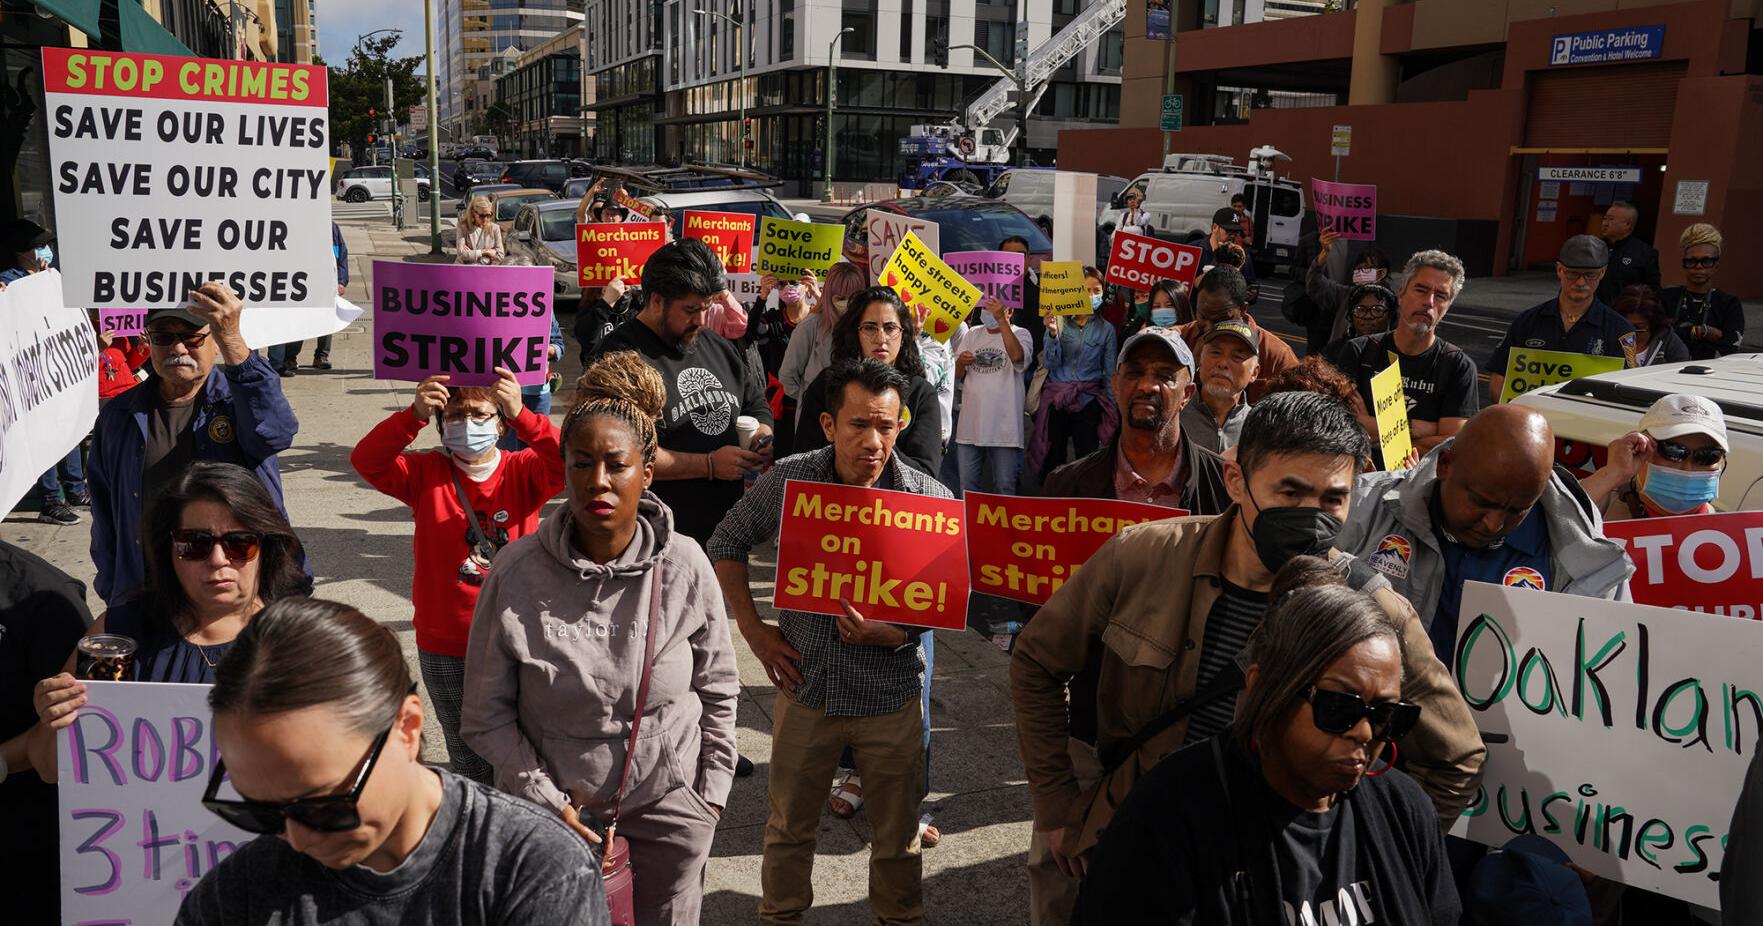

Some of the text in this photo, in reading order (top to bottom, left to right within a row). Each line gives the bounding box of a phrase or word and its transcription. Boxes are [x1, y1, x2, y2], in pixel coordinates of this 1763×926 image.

[1572, 31, 1648, 51] Public Parking
[1570, 53, 1602, 64] Convention
[1608, 52, 1623, 60] Hotel
[1624, 49, 1652, 59] Welcome
[65, 54, 310, 101] STOP CRIMES
[54, 105, 325, 148] SAVE OUR LIVES
[58, 160, 327, 200] SAVE OUR CITY
[1550, 169, 1606, 180] CLEARANCE
[110, 218, 288, 251] SAVE OUR
[688, 216, 752, 231] Merchants
[766, 223, 812, 242] Save
[582, 228, 659, 242] Merchants
[702, 235, 720, 244] on
[597, 248, 618, 257] on
[764, 242, 832, 260] Oakland
[1118, 239, 1194, 271] STOP
[583, 258, 644, 280] strik
[902, 239, 927, 268] Safe
[927, 266, 972, 307] streets,
[894, 253, 932, 295] happy
[932, 294, 962, 320] eats
[382, 286, 546, 318] BUSINESS
[1055, 300, 1084, 312] guard!
[382, 332, 545, 374] STRIKE
[1514, 354, 1573, 377] Save
[1376, 394, 1392, 416] More
[1393, 421, 1399, 436] of
[792, 493, 960, 535] Merchants
[820, 534, 861, 555] on
[1011, 542, 1056, 560] on
[785, 560, 947, 612] strike!
[980, 563, 1082, 595] stri
[544, 618, 619, 640] taylor
[1456, 613, 1763, 755] Oaklan
[71, 808, 126, 896] 3
